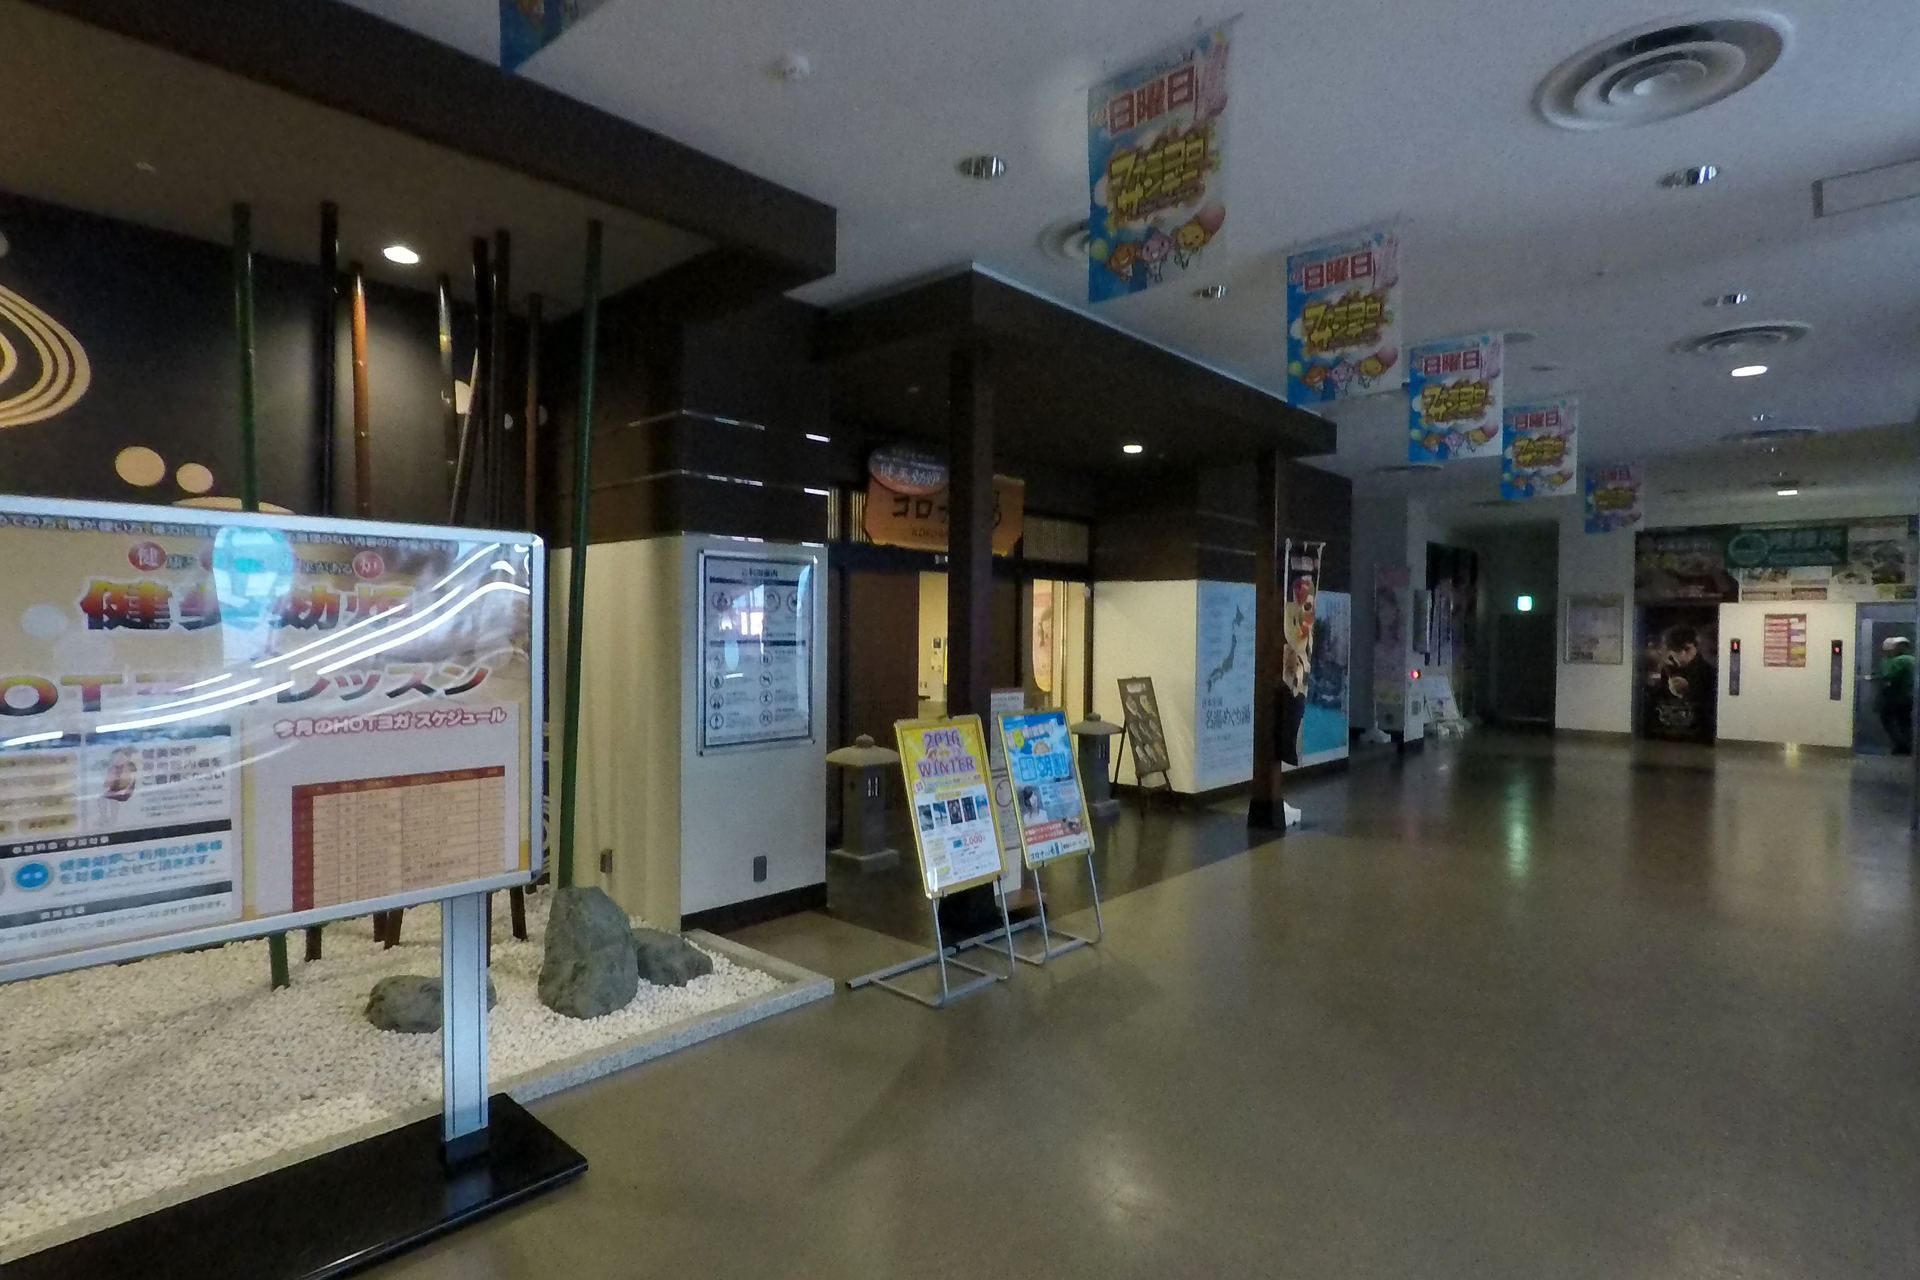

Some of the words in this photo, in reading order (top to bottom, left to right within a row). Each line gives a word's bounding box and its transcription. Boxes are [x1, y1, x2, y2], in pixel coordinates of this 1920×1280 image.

[1109, 64, 1196, 135] 日曜日
[1304, 251, 1373, 291] 日曜日
[1424, 349, 1481, 376] 日曜日
[273, 709, 413, 740] 今月のHOTヨガ
[415, 706, 507, 730] スケジュール
[924, 730, 963, 748] 2016
[918, 756, 975, 778] WINTER
